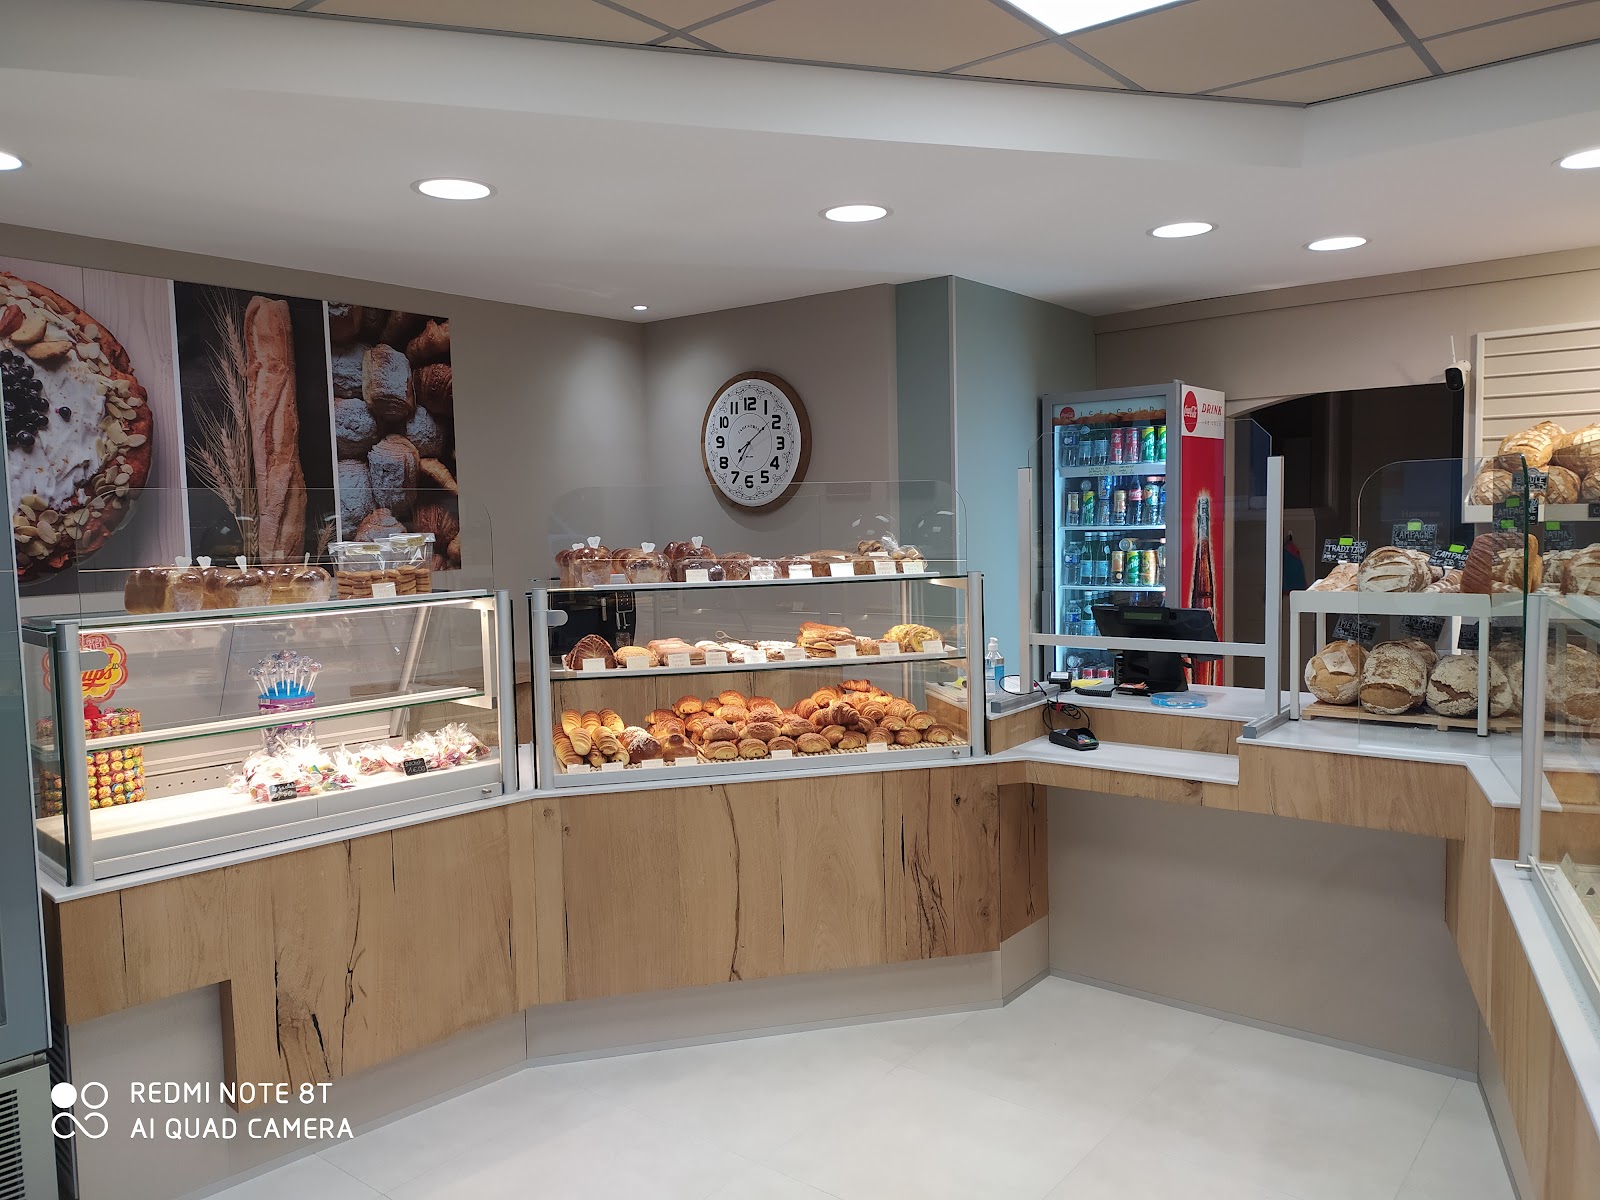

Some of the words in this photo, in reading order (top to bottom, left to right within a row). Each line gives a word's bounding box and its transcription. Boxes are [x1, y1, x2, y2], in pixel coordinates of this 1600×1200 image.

[730, 401, 739, 415] 11
[744, 397, 757, 411] 12
[1201, 403, 1223, 416] DRINK
[719, 415, 729, 429] 10
[771, 415, 782, 430] 2
[715, 435, 725, 449] 9
[776, 436, 785, 451] 3
[719, 456, 729, 469] 8
[770, 455, 780, 470] 4
[730, 470, 740, 484] 7
[744, 475, 754, 489] 6
[760, 470, 770, 484] 5
[1394, 530, 1434, 540] CAMPAGNE
